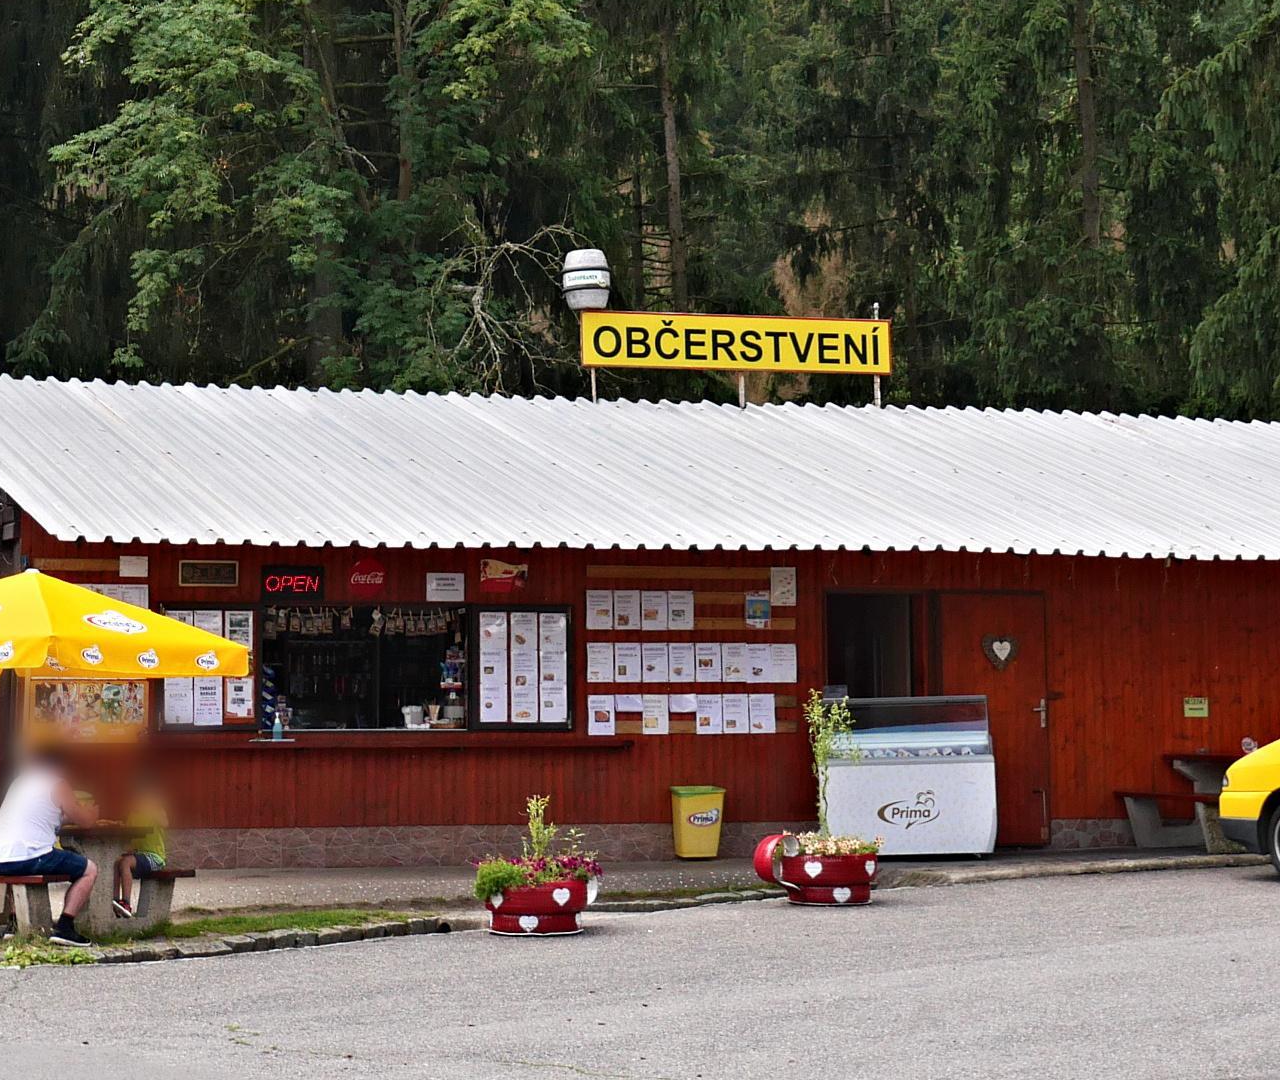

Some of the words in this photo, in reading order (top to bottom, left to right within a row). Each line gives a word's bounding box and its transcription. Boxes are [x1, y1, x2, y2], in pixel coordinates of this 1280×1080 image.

[592, 320, 881, 366] OBČERSTVENÍ
[266, 575, 319, 592] OPEN
[351, 571, 384, 584] Coca-Cola
[891, 806, 931, 819] Prima
